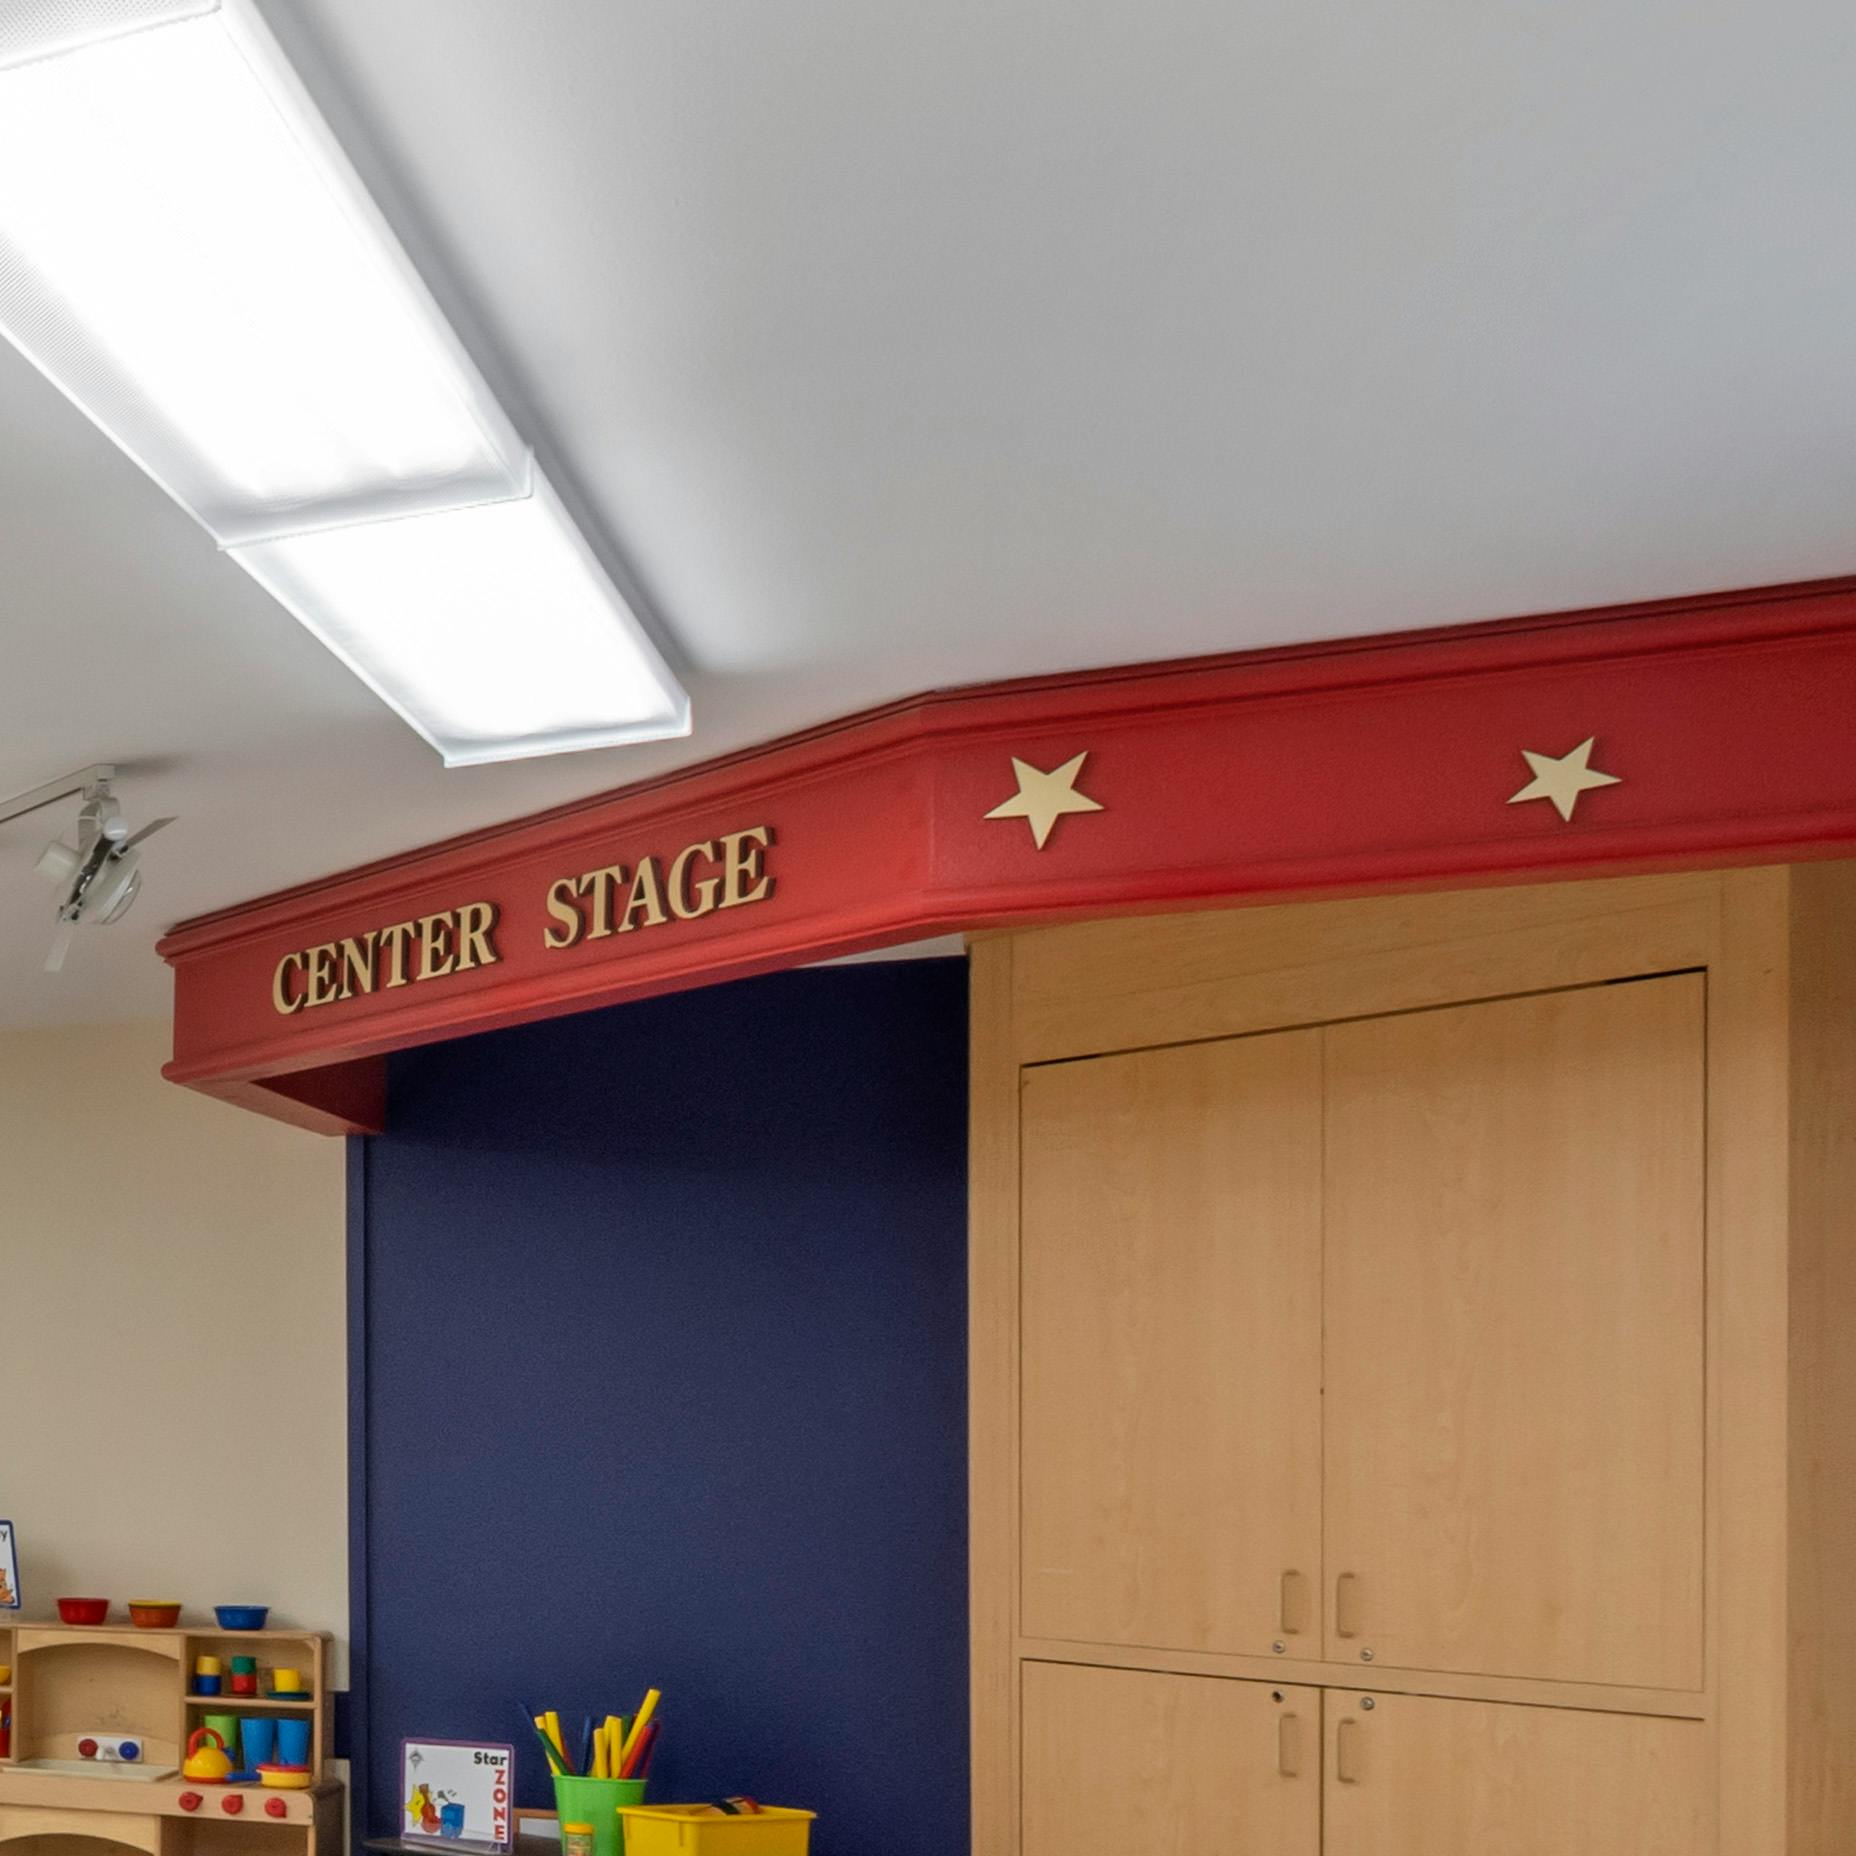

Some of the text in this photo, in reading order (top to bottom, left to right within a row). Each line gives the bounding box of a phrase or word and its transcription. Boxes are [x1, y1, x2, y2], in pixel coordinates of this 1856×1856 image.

[272, 825, 773, 1015] CENTER STAGE
[473, 1751, 508, 1767] Star
[493, 1769, 507, 1841] ZONE
